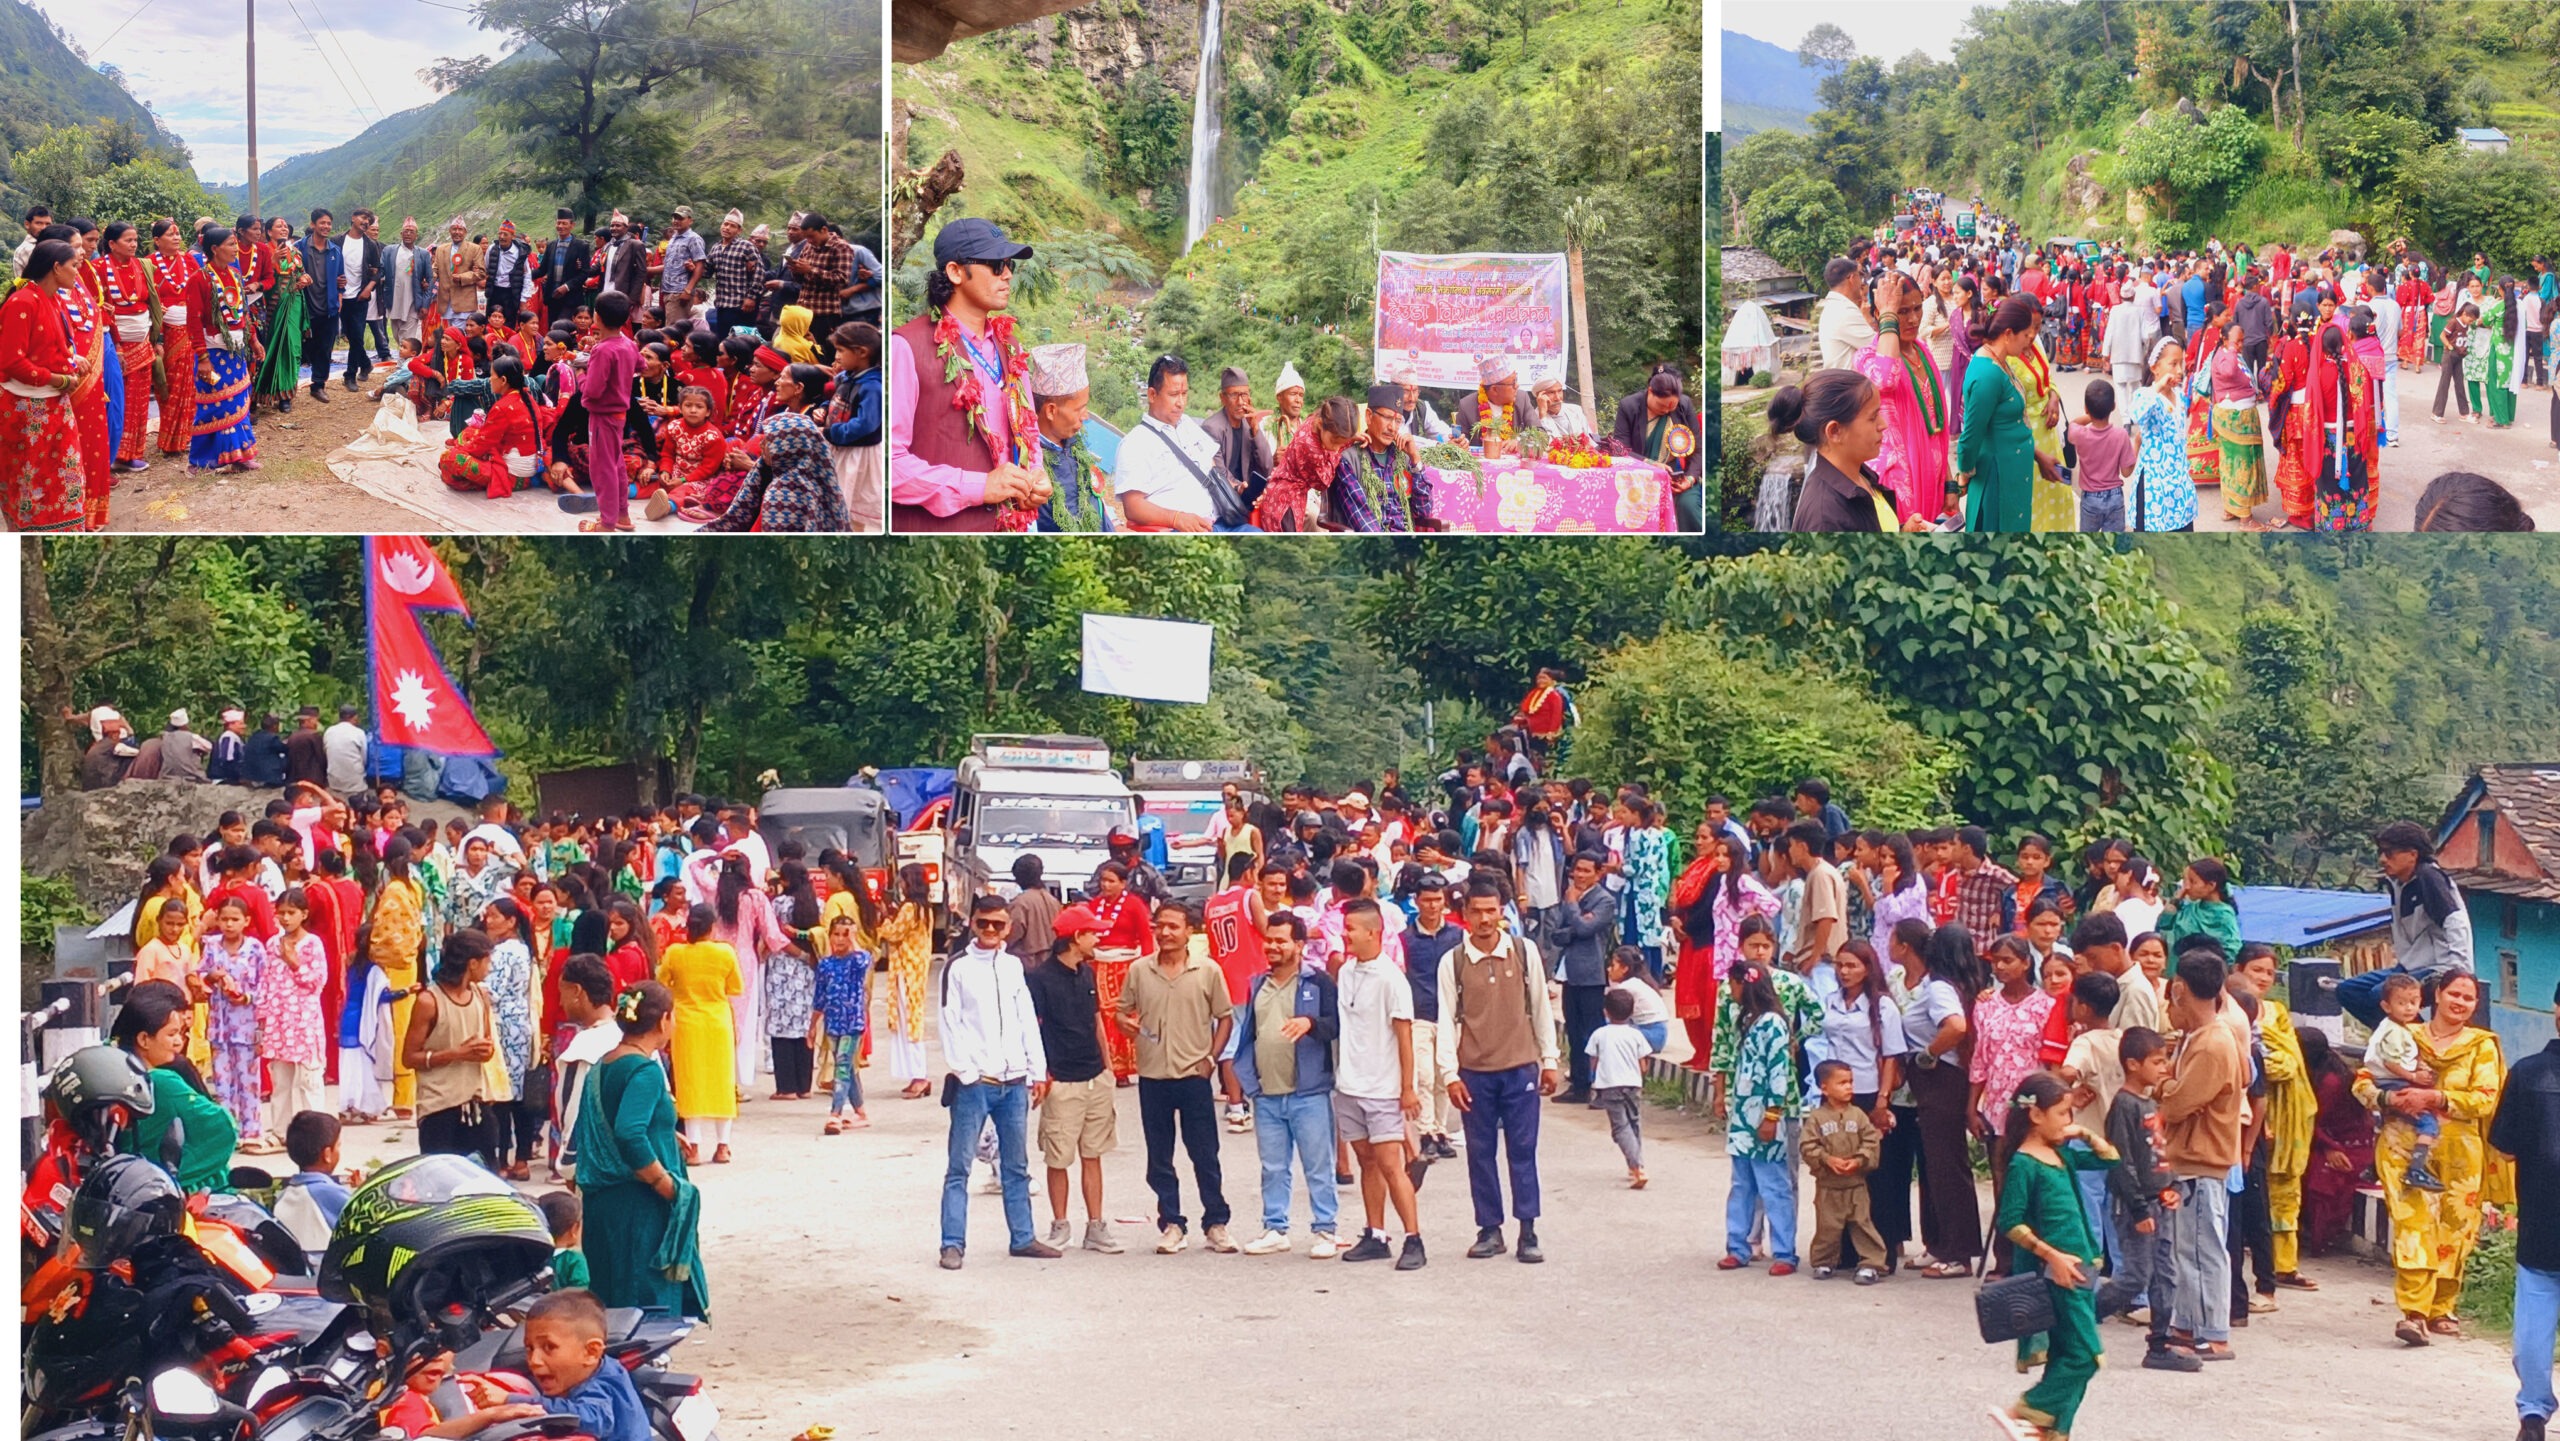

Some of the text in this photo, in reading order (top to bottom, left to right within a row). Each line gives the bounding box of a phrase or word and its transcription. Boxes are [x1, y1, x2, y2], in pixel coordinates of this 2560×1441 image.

[1388, 299, 1429, 321] देउडा
[1484, 301, 1552, 324] कार्यक्रम
[1211, 915, 1239, 957] 10
